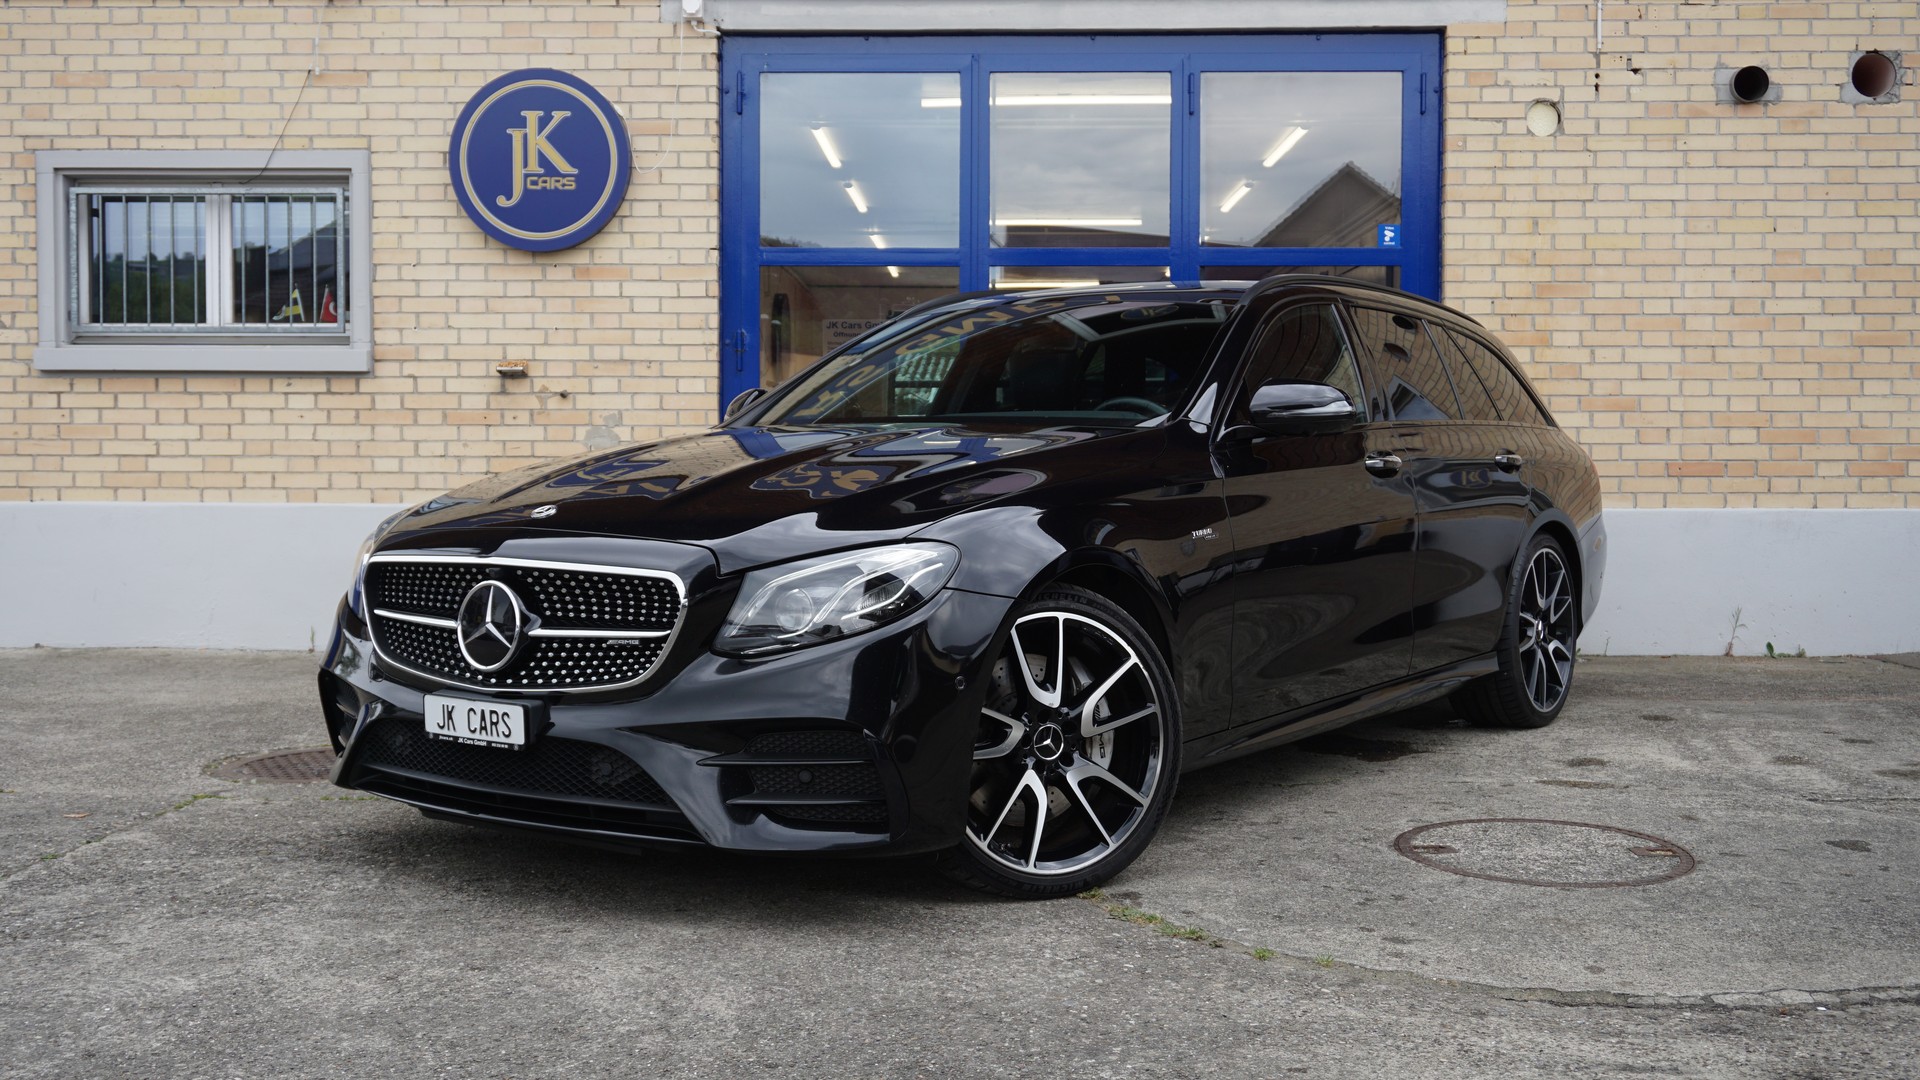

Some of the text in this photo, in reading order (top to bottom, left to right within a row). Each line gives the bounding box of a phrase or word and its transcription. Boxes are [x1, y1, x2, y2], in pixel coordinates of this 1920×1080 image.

[496, 110, 578, 207] JK
[526, 176, 576, 190] CARS
[826, 321, 839, 329] JK
[841, 321, 862, 329] Cars
[1034, 592, 1088, 604] ICHELIN
[437, 704, 512, 738] JK CARS
[474, 739, 487, 747] GmbH
[1098, 734, 1106, 759] MG
